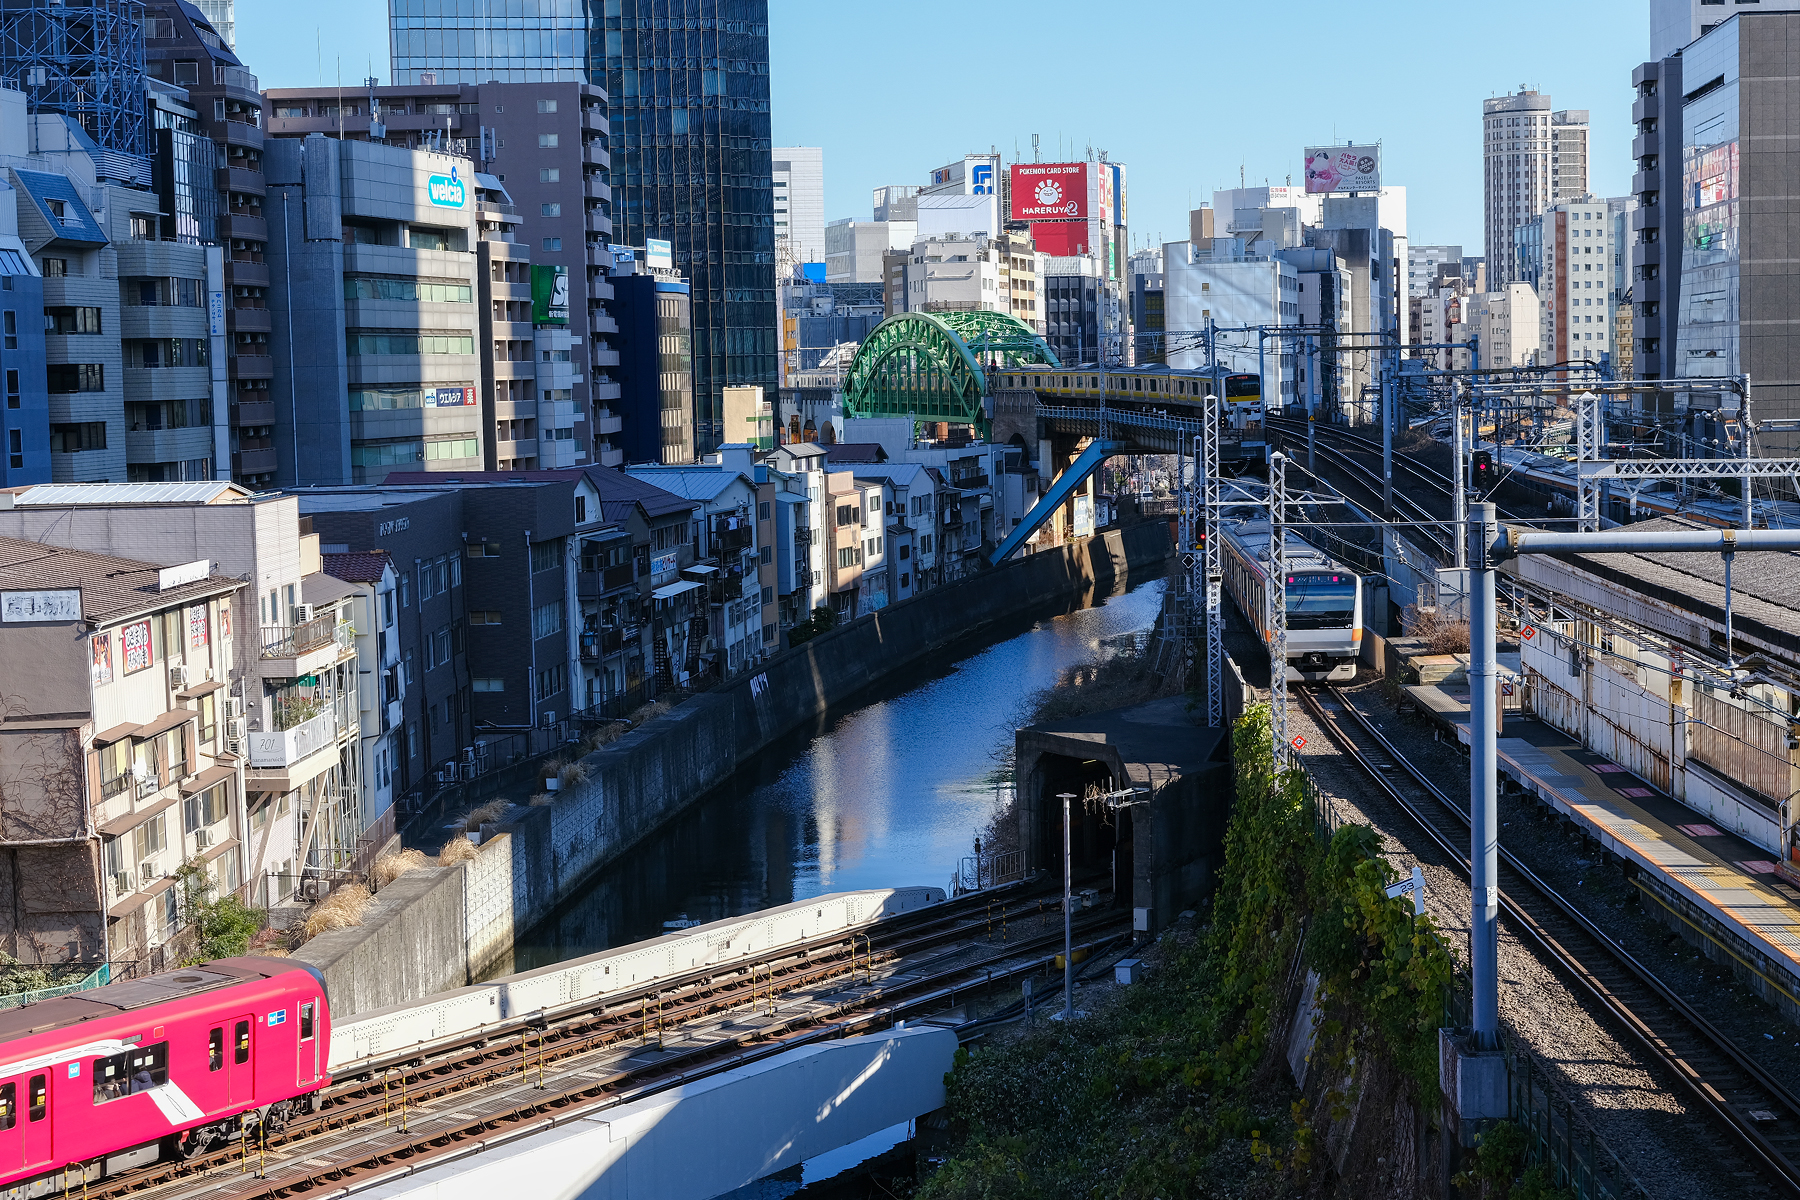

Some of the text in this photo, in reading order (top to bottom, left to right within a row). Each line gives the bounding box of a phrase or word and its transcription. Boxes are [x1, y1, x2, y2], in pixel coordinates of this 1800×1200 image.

[1341, 152, 1357, 160] パセラ
[1062, 166, 1080, 174] STORE
[430, 180, 462, 203] welcia
[466, 388, 474, 405] 薬
[1400, 882, 1415, 893] 23
